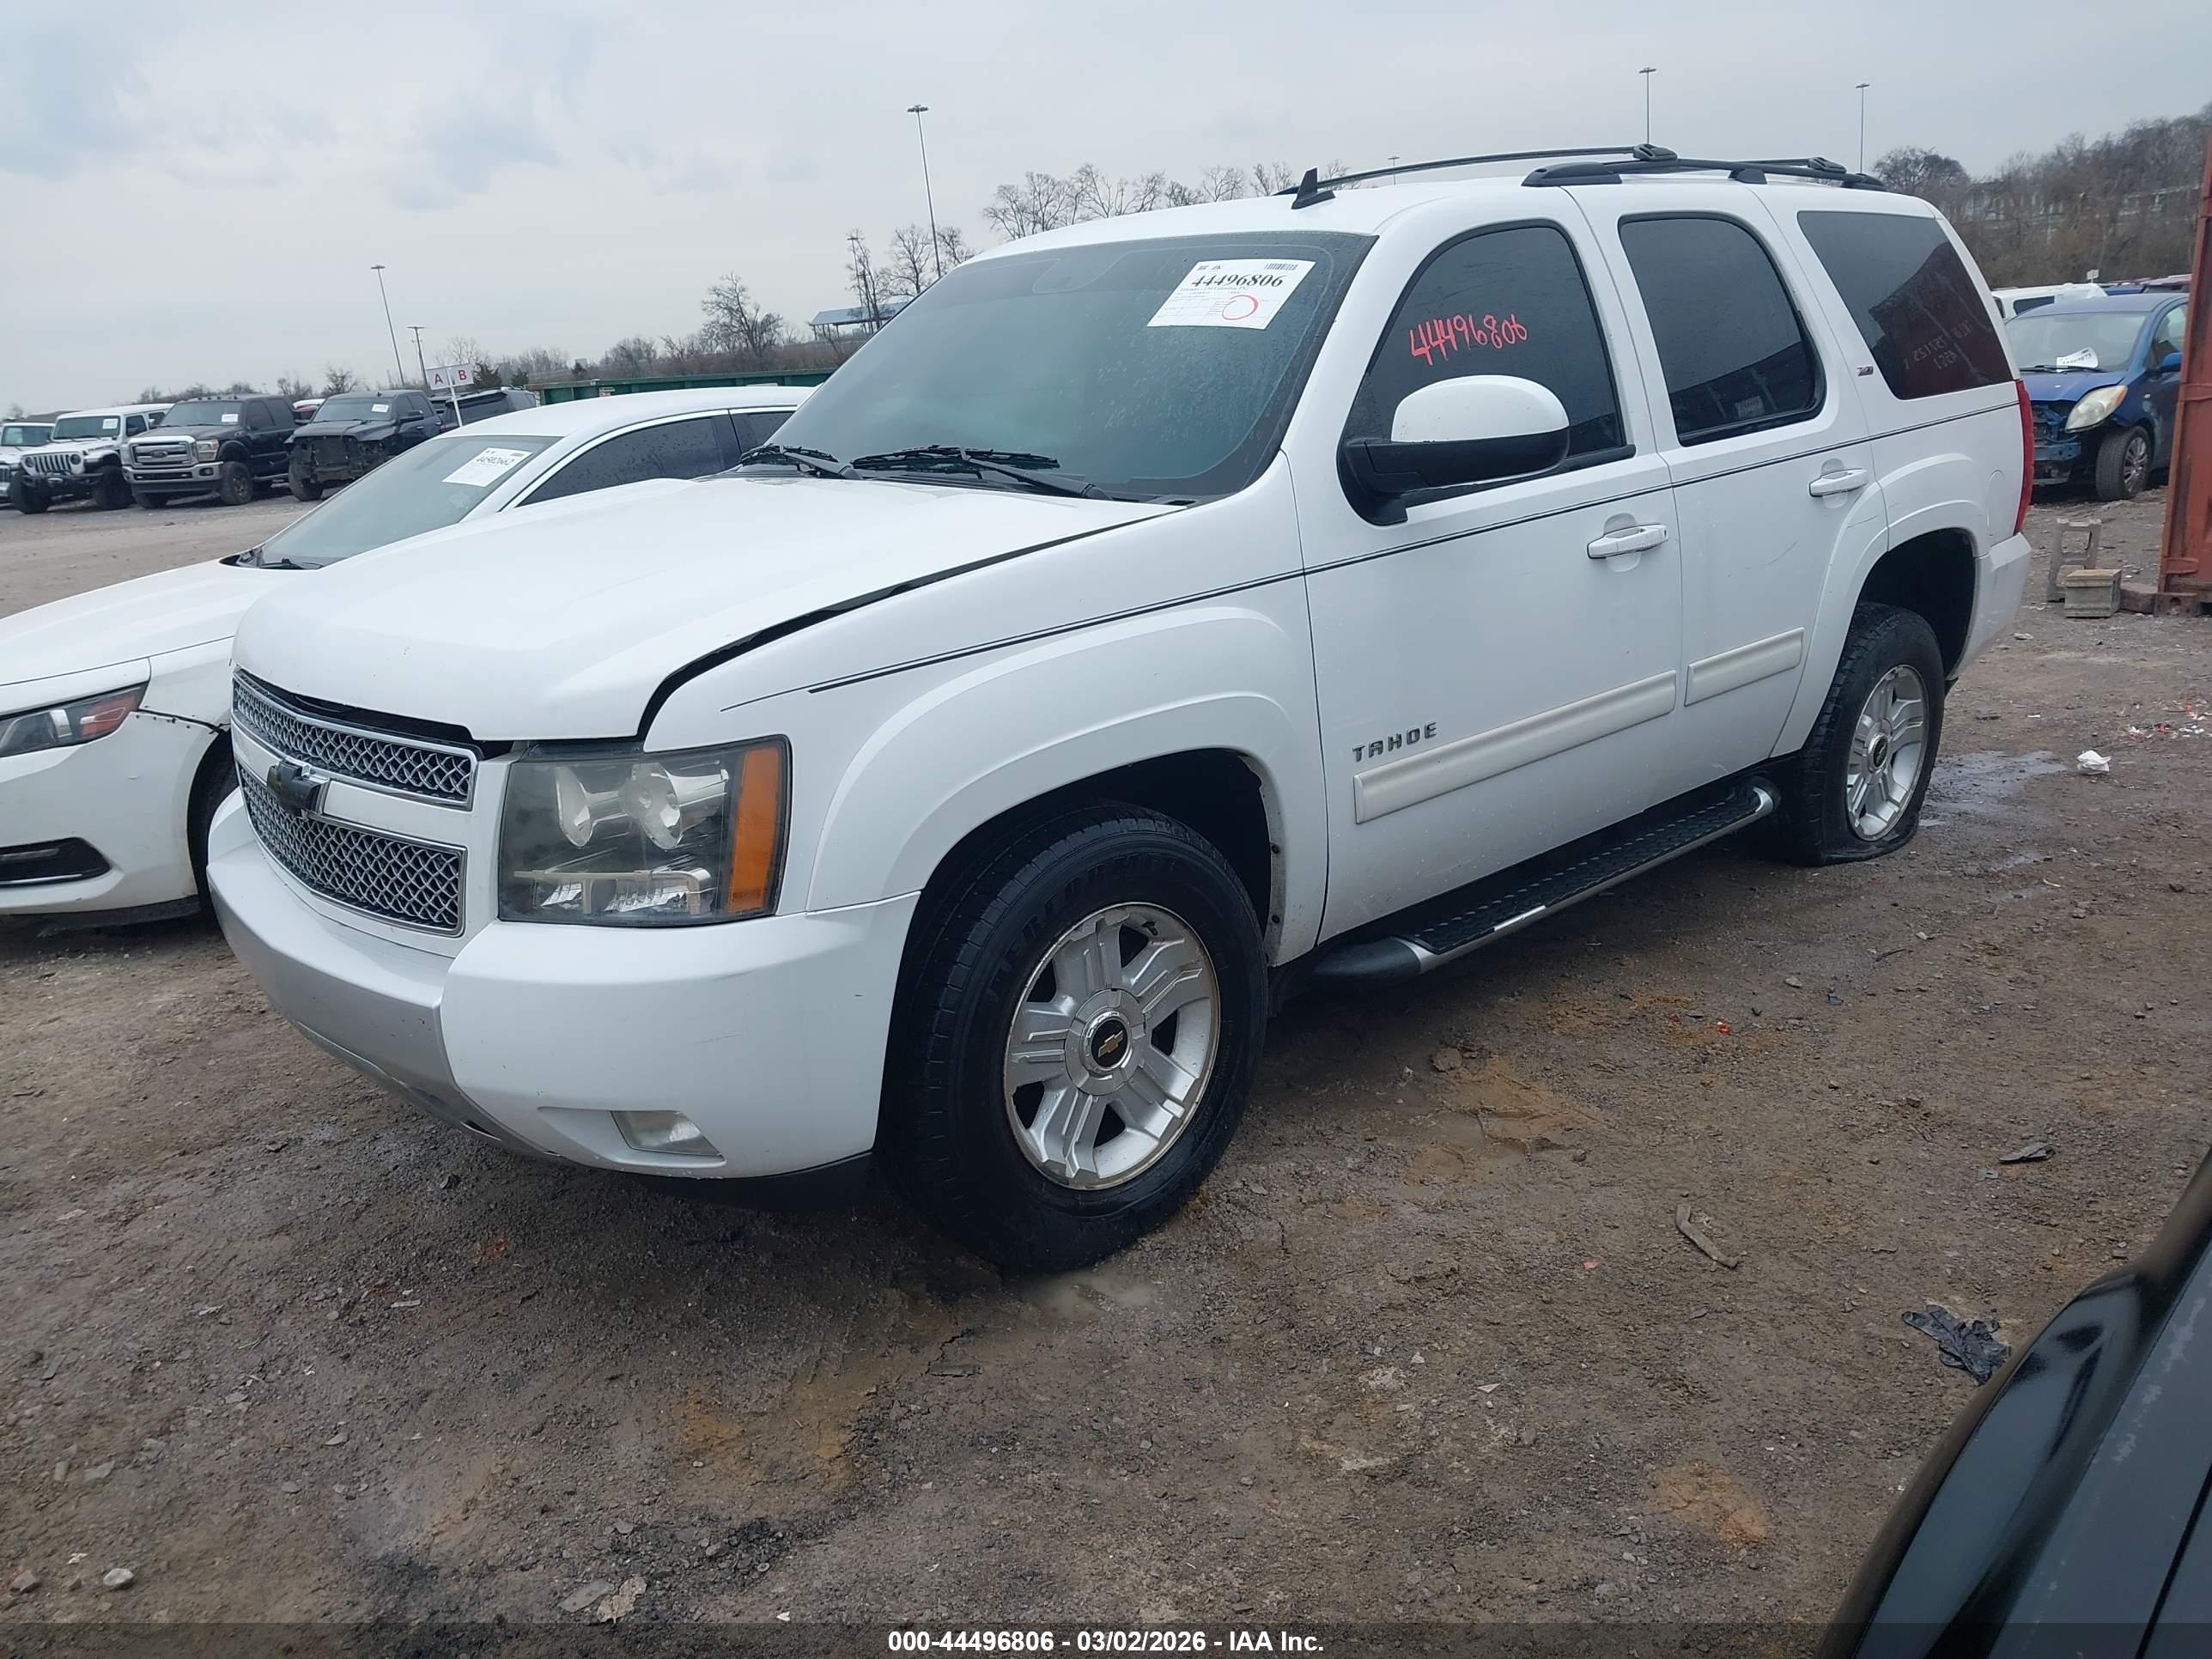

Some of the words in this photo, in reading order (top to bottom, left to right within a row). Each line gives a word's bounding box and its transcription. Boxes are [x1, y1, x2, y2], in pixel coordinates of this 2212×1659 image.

[1192, 274, 1285, 287] 44496806
[1409, 313, 1528, 366] 44496806
[434, 374, 444, 385] A
[458, 369, 467, 380] B
[1352, 721, 1437, 763] TAHOE
